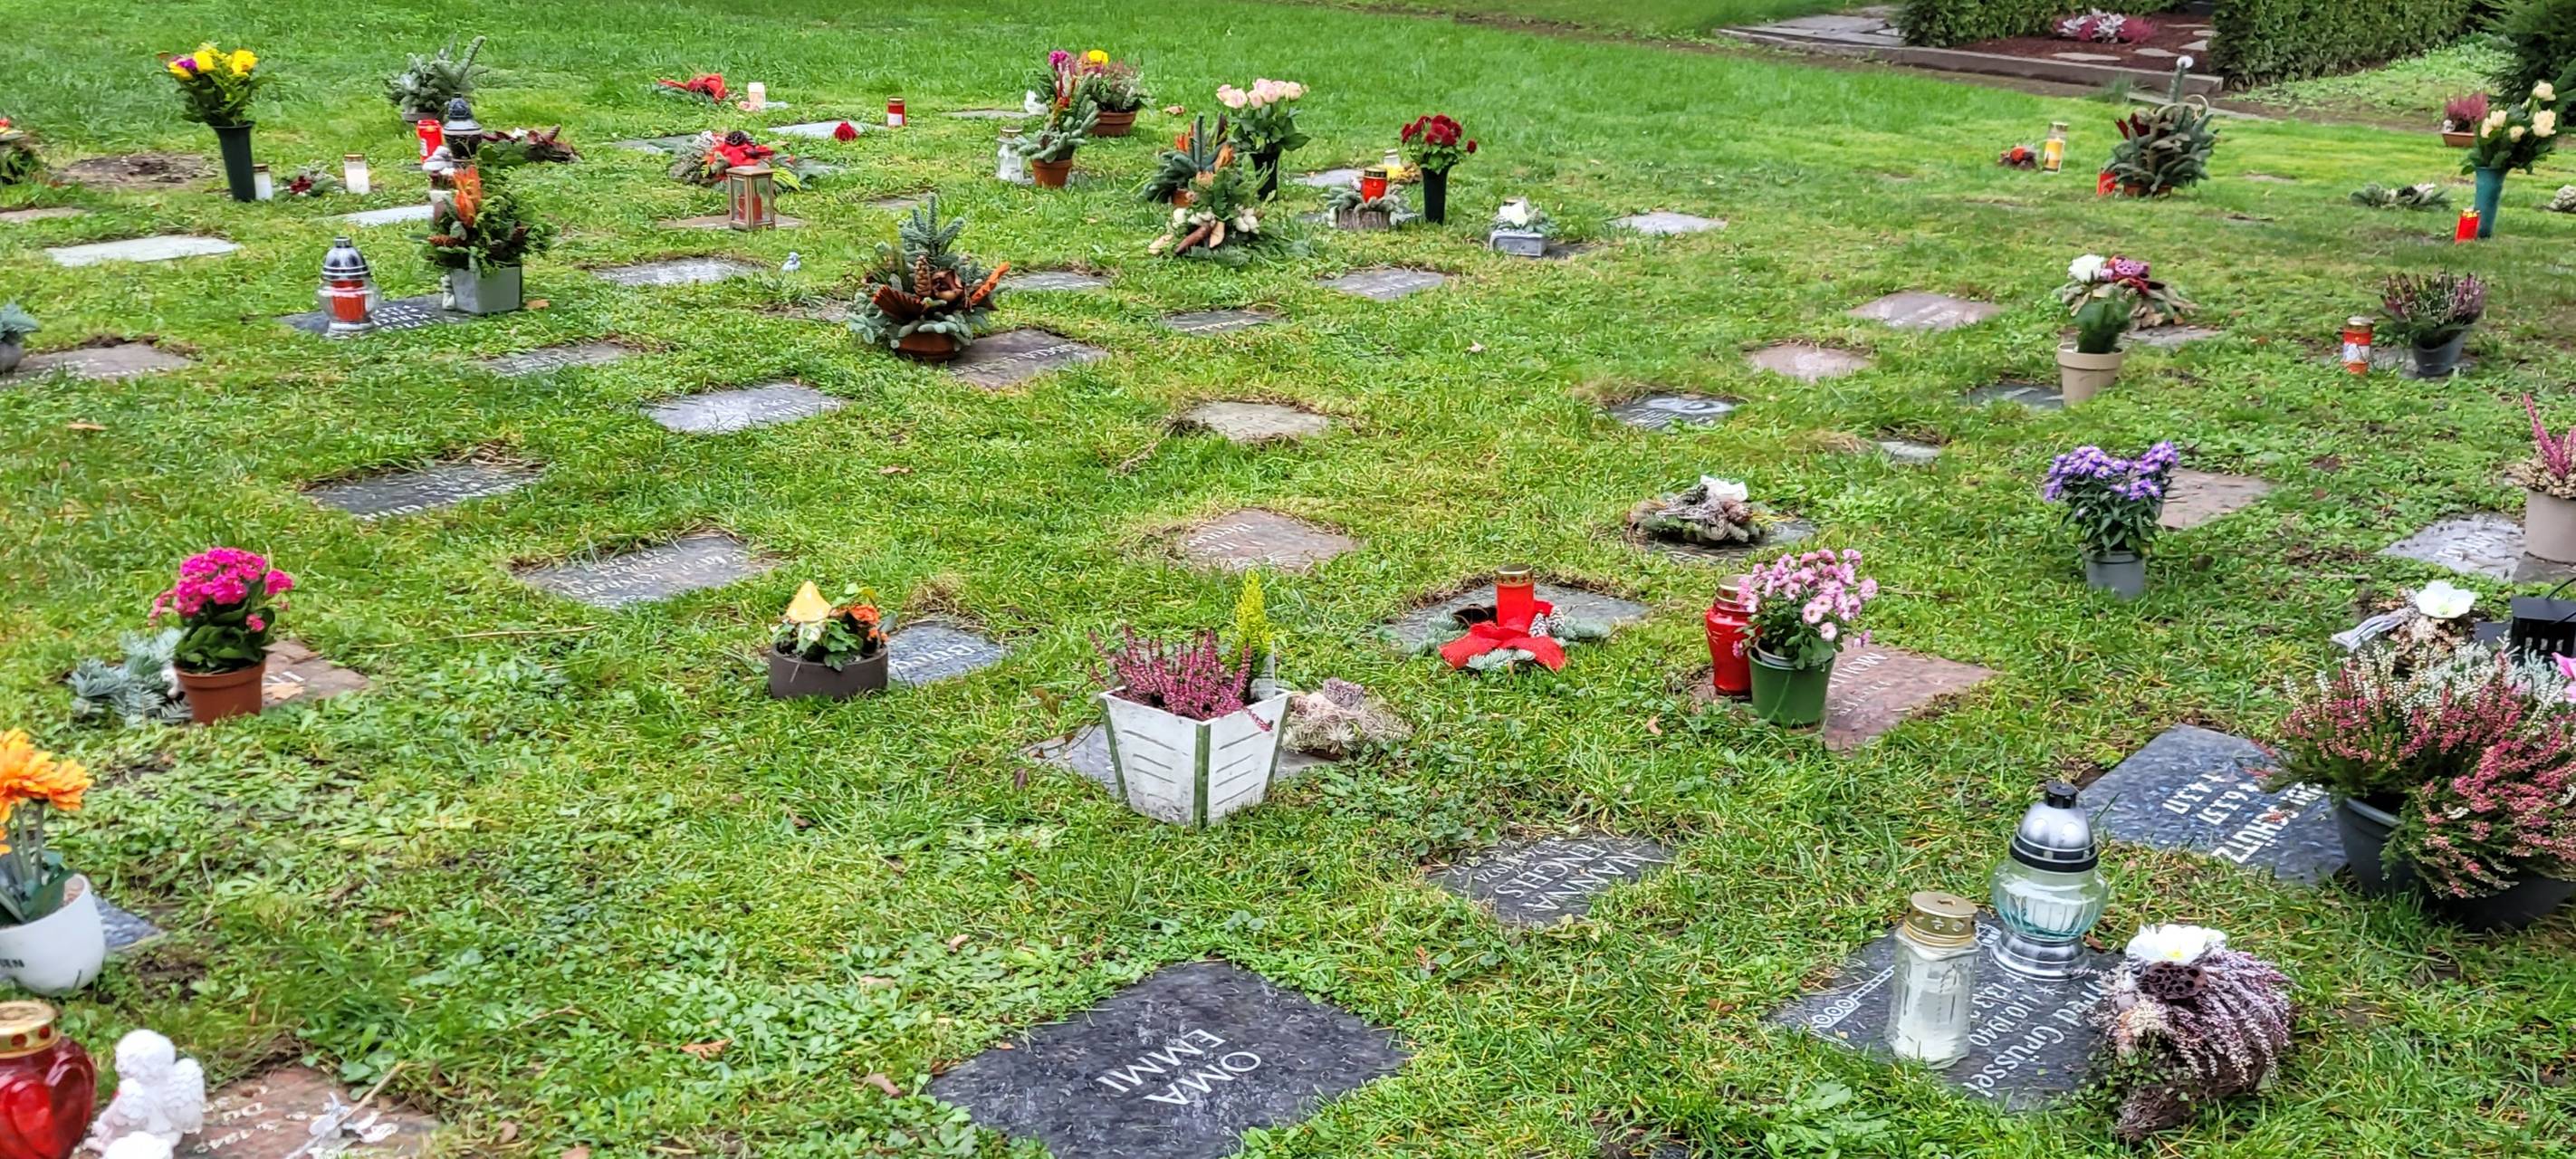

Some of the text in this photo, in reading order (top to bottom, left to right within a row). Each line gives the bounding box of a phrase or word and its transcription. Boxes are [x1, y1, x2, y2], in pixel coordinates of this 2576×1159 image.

[1494, 843, 1607, 899] ENGELS
[1095, 1028, 1227, 1093] EMMI
[1143, 1051, 1262, 1106] OMA
